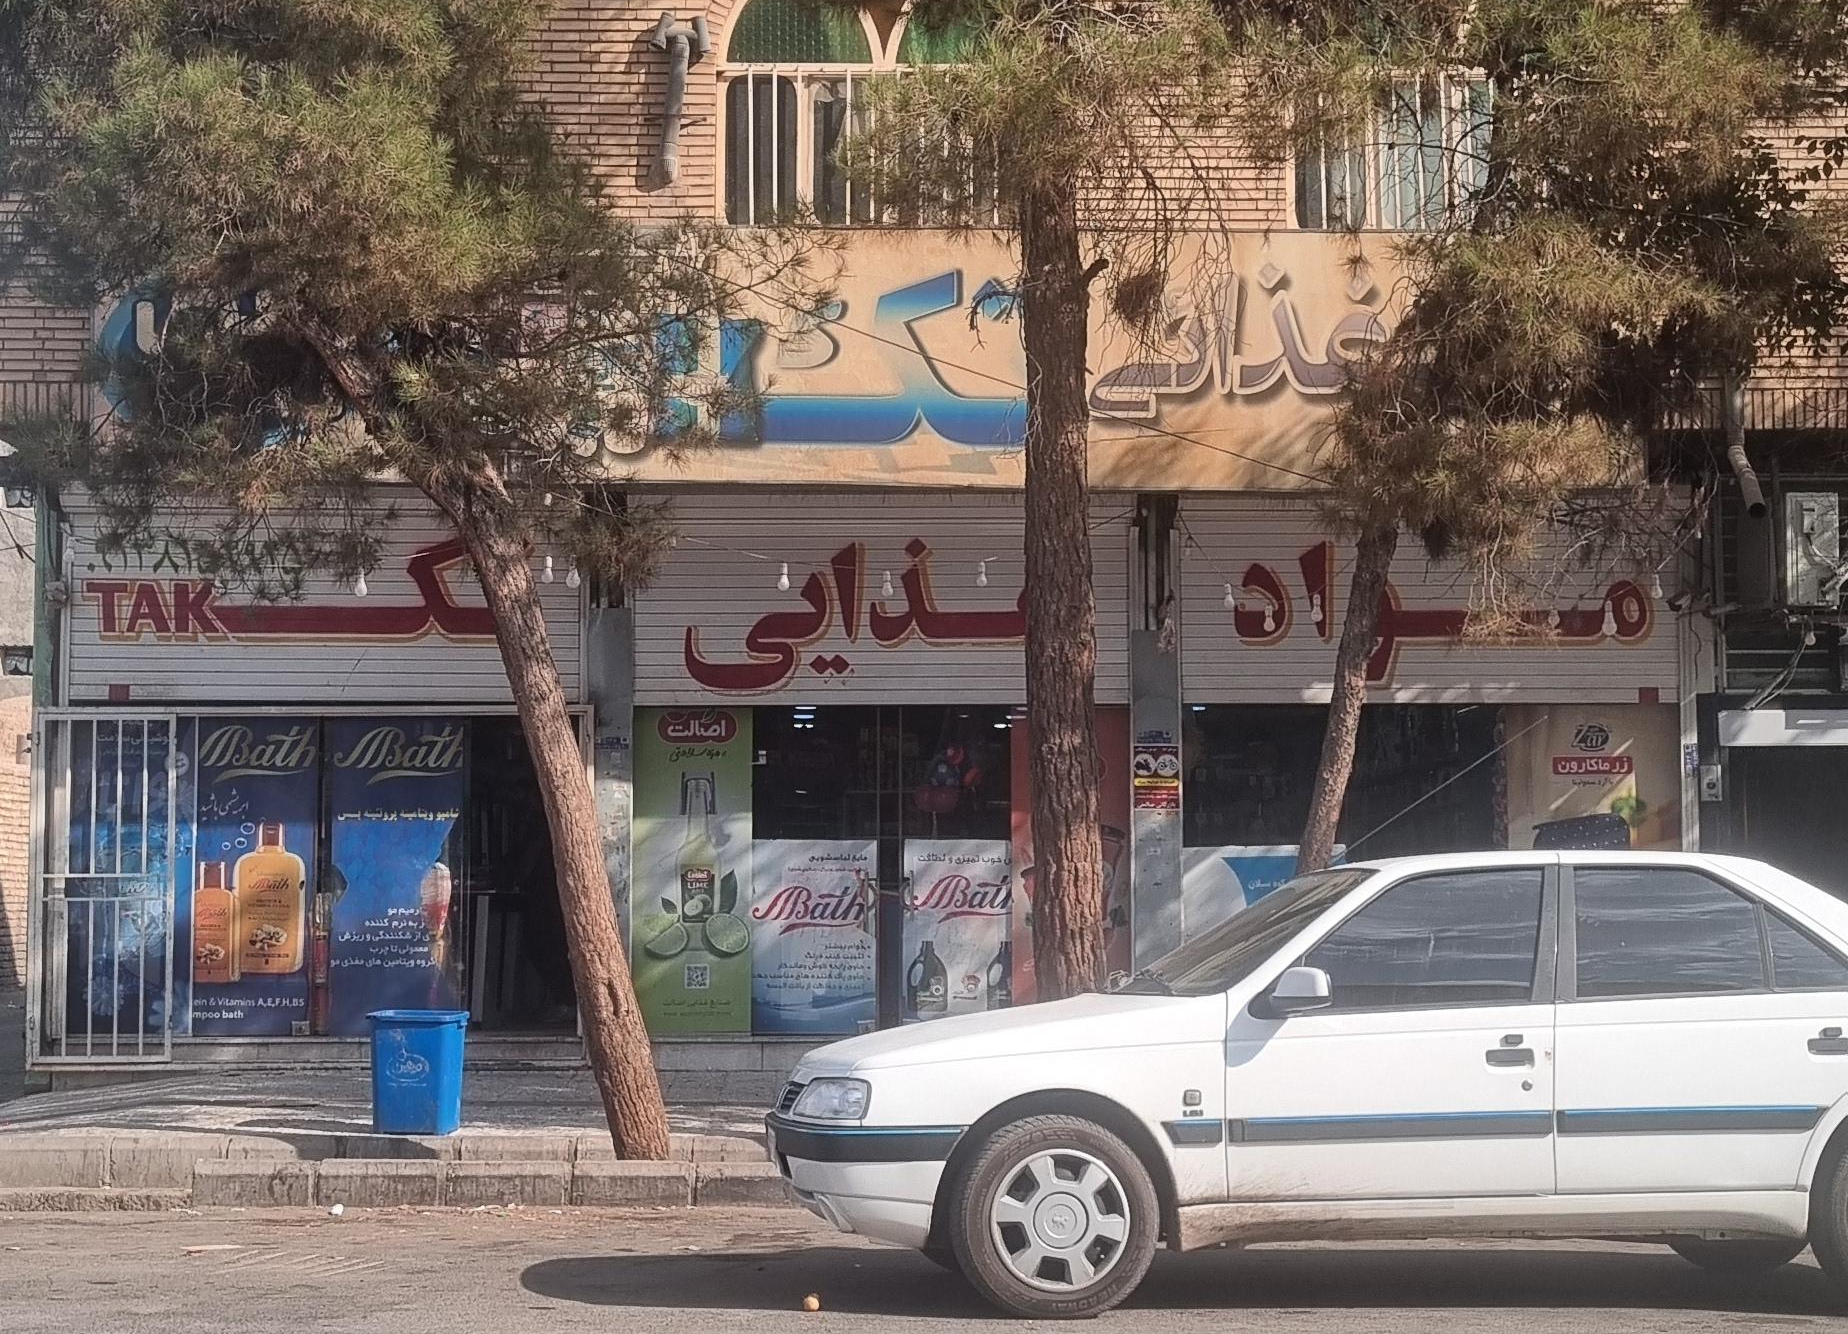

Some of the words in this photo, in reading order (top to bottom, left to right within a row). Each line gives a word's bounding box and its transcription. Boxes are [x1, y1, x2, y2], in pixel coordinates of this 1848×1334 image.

[82, 578, 226, 641] TAK
[684, 538, 1028, 693] ذایی
[666, 719, 726, 737] اصالت
[200, 725, 317, 767] Bath
[333, 726, 463, 768] Bath
[1557, 758, 1611, 773] ماکارون
[1611, 757, 1629, 773] زر
[954, 854, 980, 865] تمیزی
[981, 856, 1003, 865] خوب
[752, 885, 867, 921] Bath
[364, 918, 389, 927] کننده
[217, 997, 255, 1006] Vitamins
[222, 1009, 244, 1019] bath
